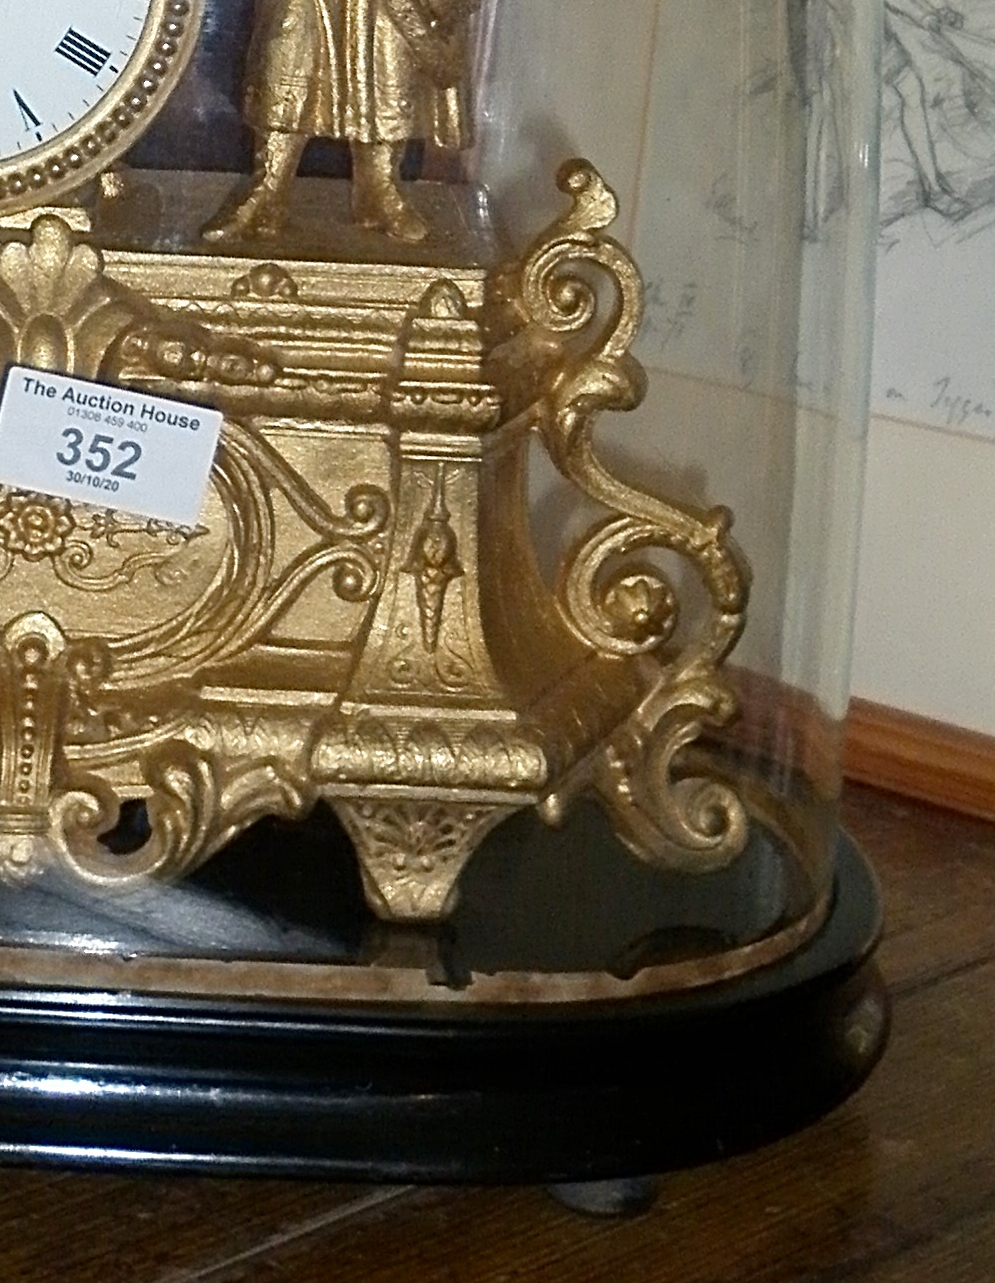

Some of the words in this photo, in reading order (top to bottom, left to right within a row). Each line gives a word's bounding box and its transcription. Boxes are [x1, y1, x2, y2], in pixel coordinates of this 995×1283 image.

[54, 27, 111, 77] IIII
[13, 88, 44, 131] V
[22, 377, 57, 398] The
[62, 387, 135, 416] Auction
[140, 403, 201, 431] House
[104, 414, 125, 428] 459
[127, 420, 148, 433] 400
[56, 427, 142, 480] 352
[66, 470, 120, 492] 30/10/20
